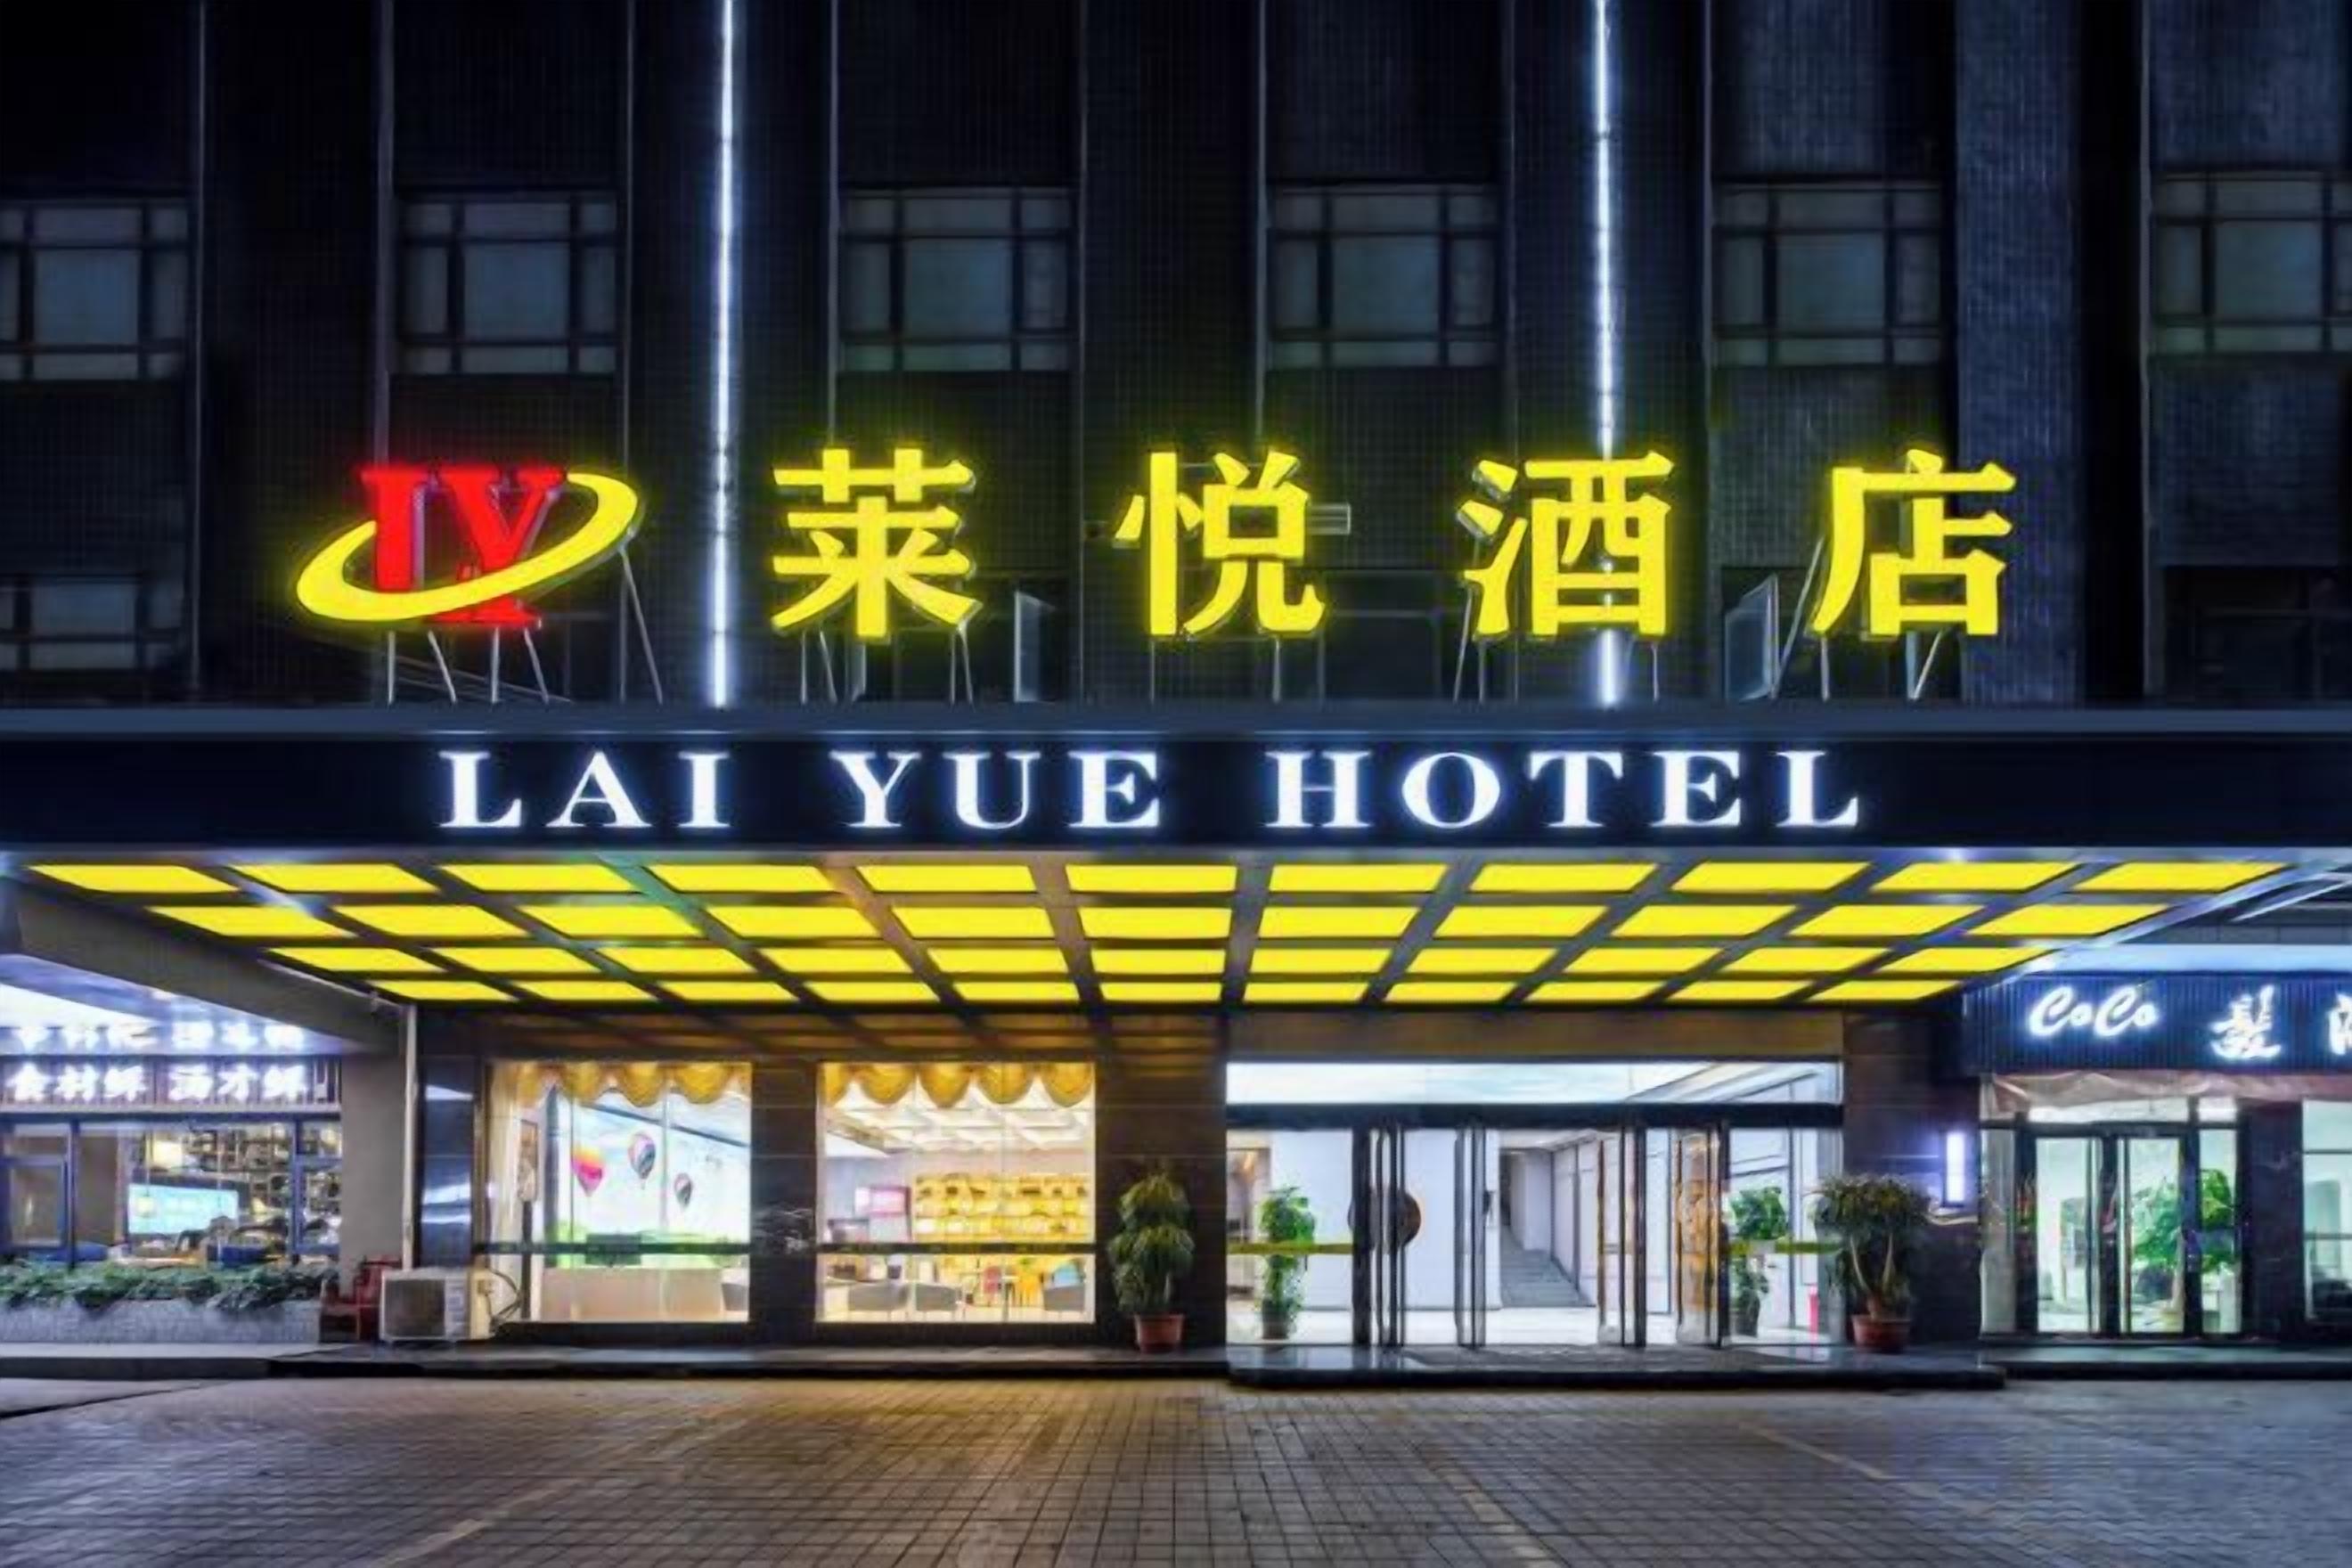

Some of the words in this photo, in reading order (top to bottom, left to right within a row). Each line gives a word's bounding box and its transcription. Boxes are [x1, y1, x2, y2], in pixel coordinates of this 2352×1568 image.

[772, 447, 2016, 641] 莱悦酒店
[440, 752, 727, 829] LAI
[831, 751, 1160, 829] YUE
[1266, 750, 1859, 829] HOTEL
[2027, 984, 2160, 1038] CoCo
